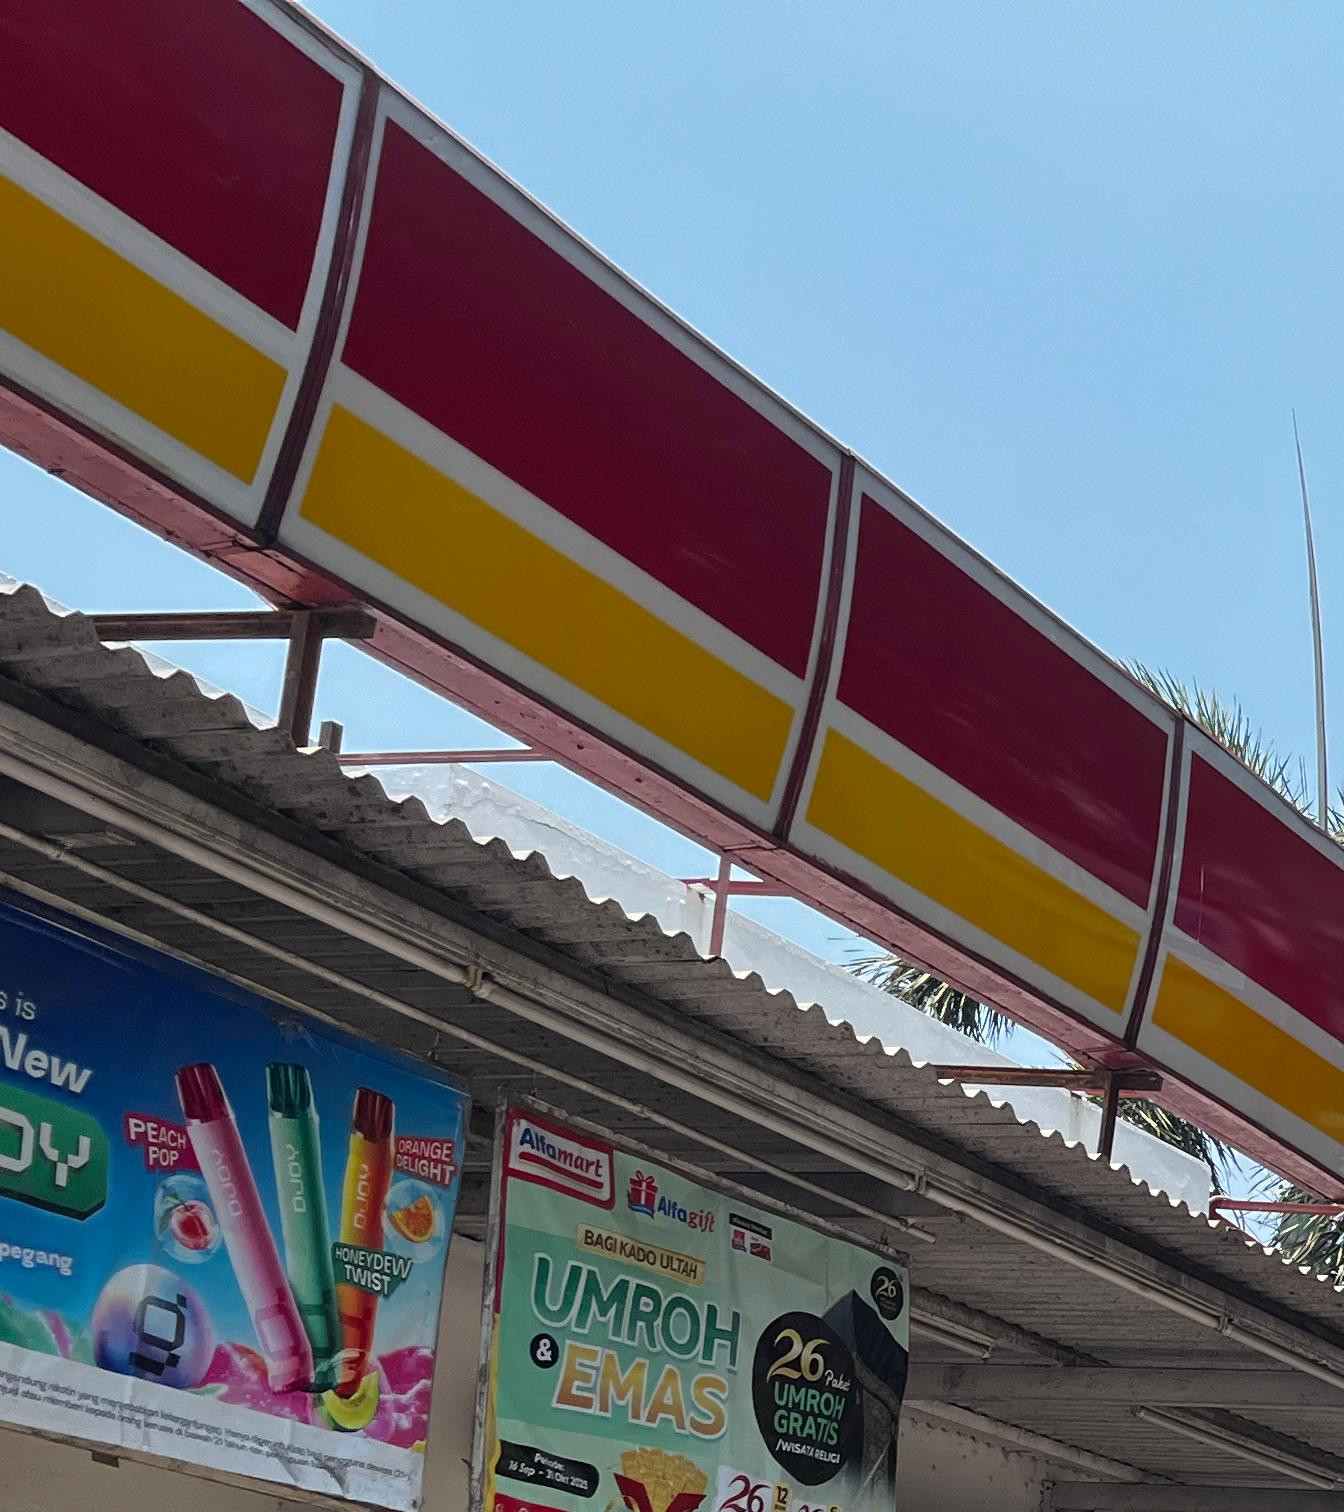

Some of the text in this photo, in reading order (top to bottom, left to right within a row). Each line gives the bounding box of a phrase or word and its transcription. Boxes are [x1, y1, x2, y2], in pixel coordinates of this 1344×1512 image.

[128, 1118, 187, 1149] PEACH
[399, 1139, 453, 1161] ORANGE
[149, 1146, 179, 1167] POP
[520, 1127, 603, 1177] Alfamart
[396, 1155, 455, 1185] DELIGHT
[657, 1196, 715, 1233] Alfagift
[336, 1248, 412, 1279] HONEYDEW
[584, 1230, 698, 1279] BAGI KADO ULTAH
[345, 1265, 391, 1295] TWIST
[531, 1253, 741, 1371] UMROH
[767, 1328, 831, 1382] 26
[552, 1339, 729, 1440] EMAS
[774, 1381, 846, 1420] UMROH
[774, 1410, 839, 1445] GRATIS
[776, 1485, 789, 1505] 12
